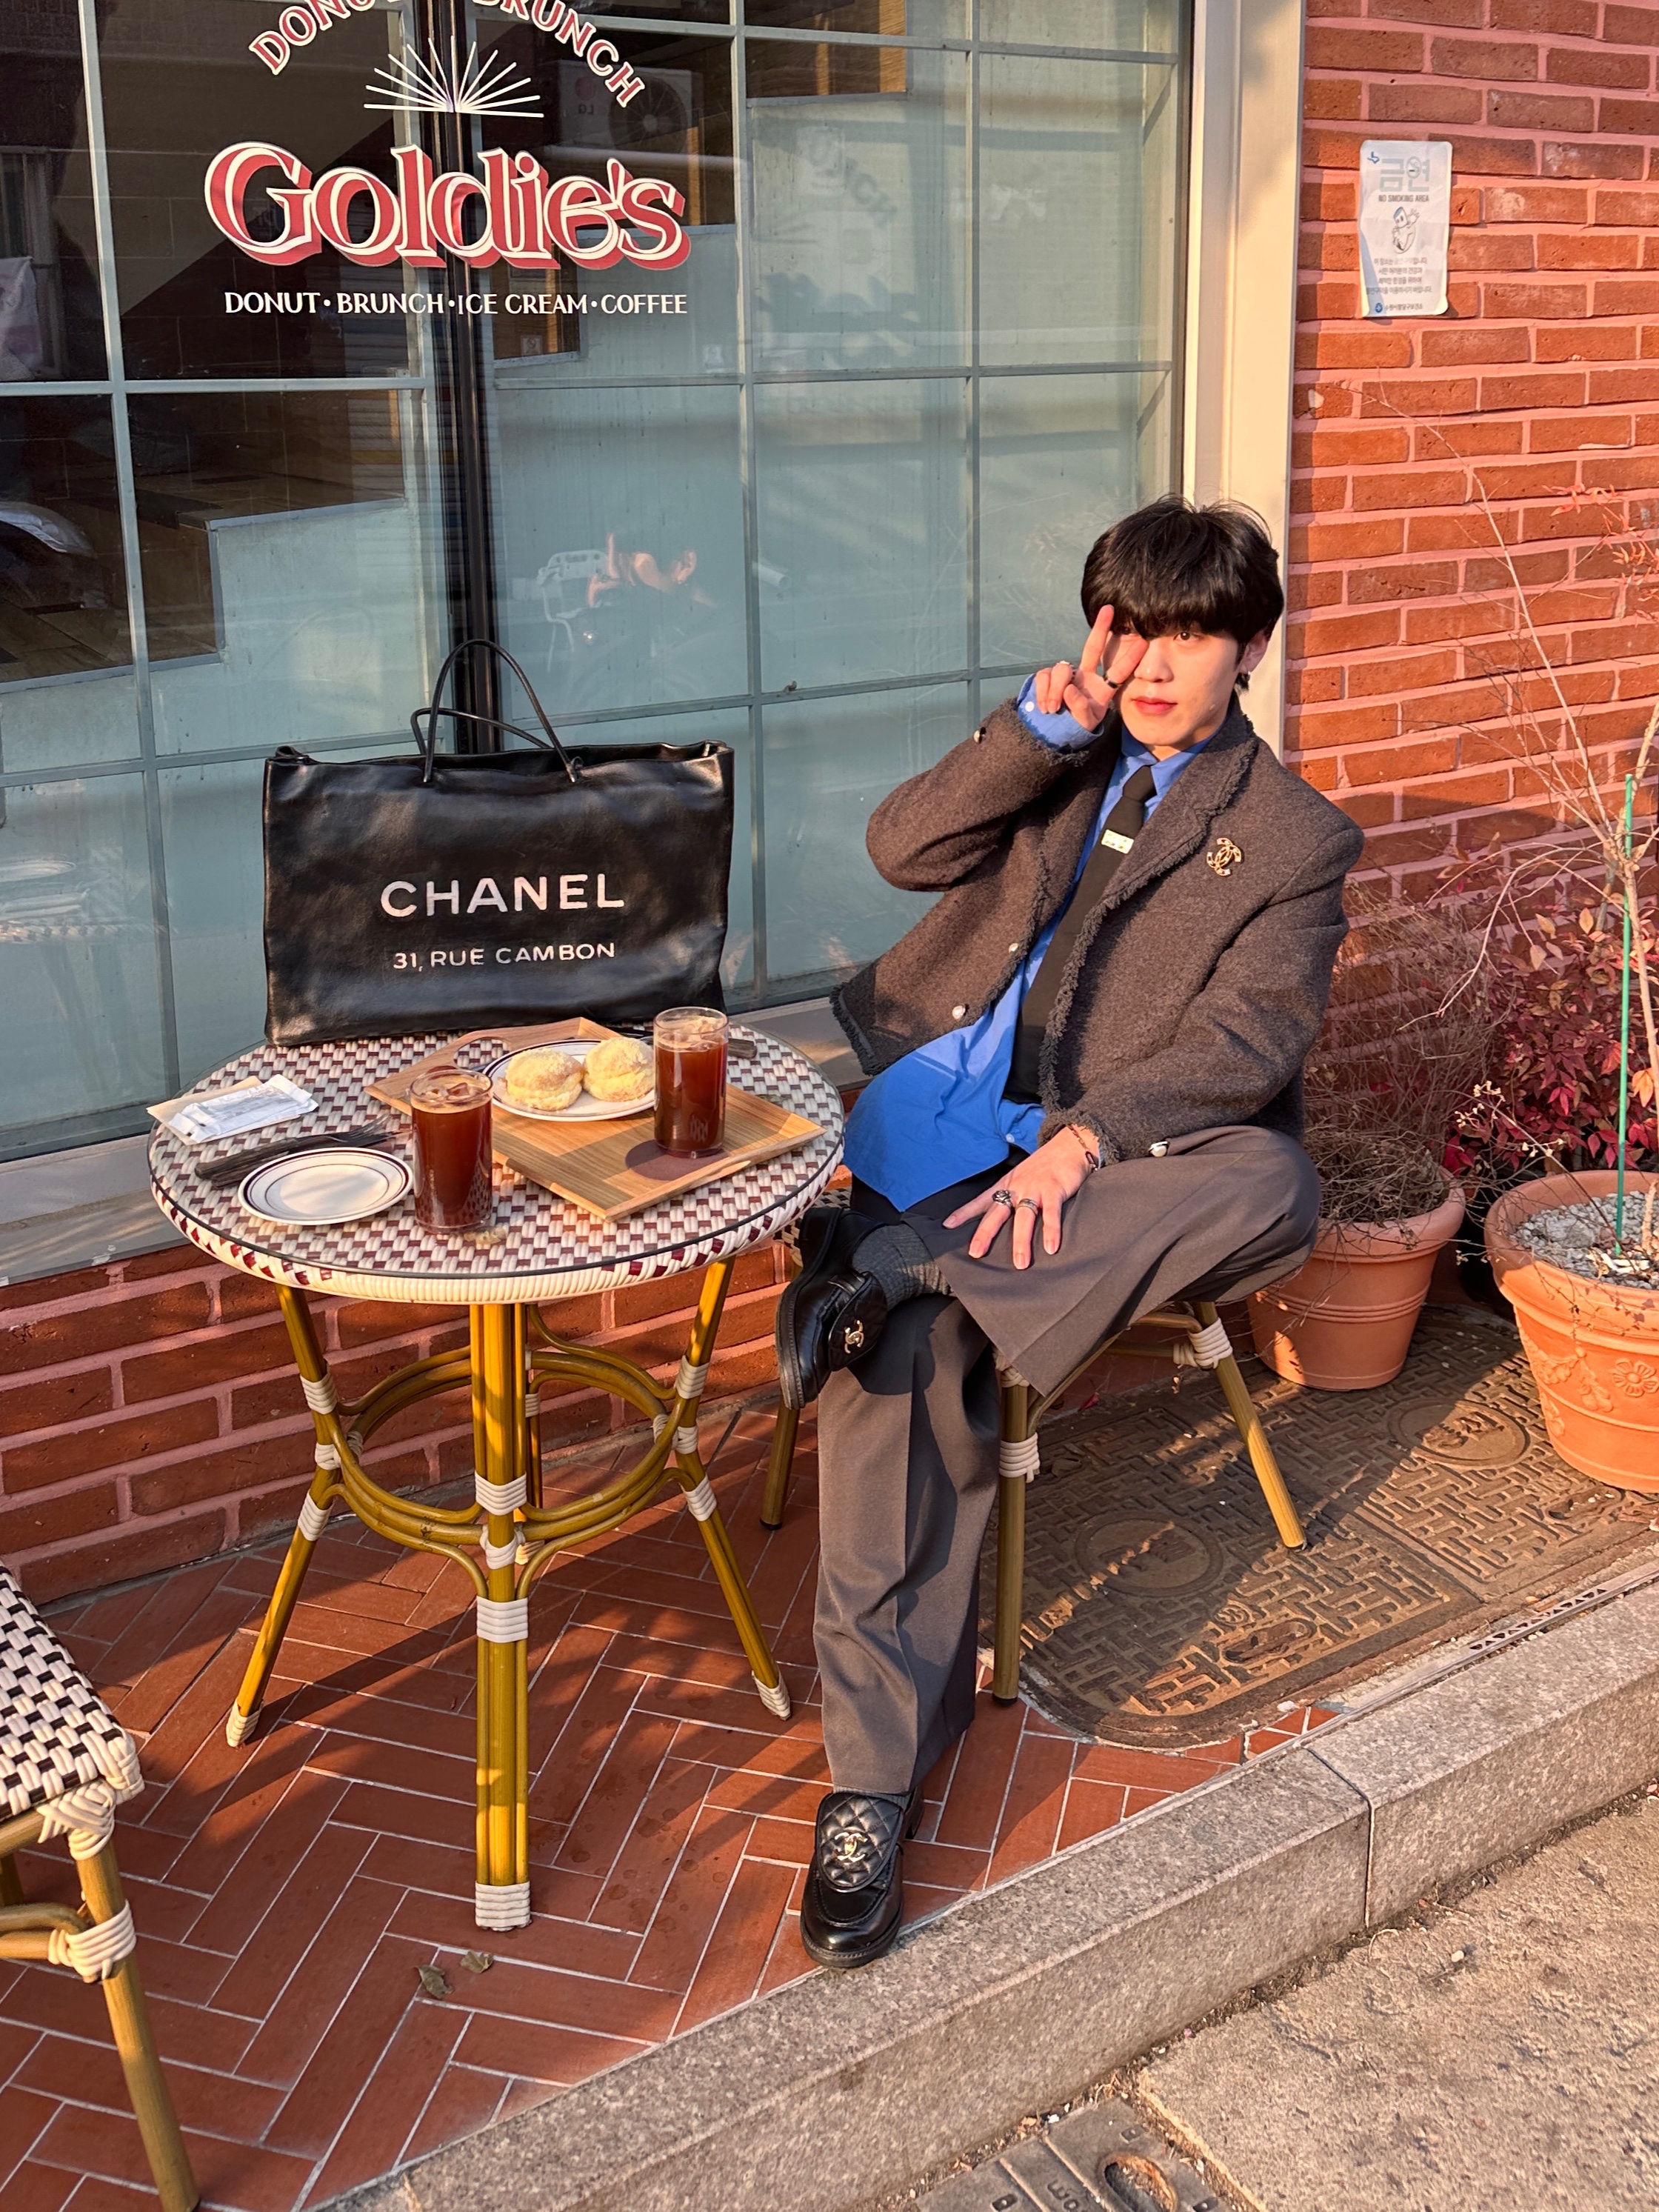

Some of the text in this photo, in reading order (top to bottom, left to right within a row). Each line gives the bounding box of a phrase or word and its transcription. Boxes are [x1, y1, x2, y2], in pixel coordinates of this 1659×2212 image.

[204, 141, 692, 271] Goldie's
[1378, 194, 1430, 202] NO SMOKING AREA
[224, 292, 687, 315] DONUT BRUNCH ICE CREAM COFFEE
[381, 873, 624, 917] CHANEL
[393, 942, 615, 972] 31, RUE CAMBON
